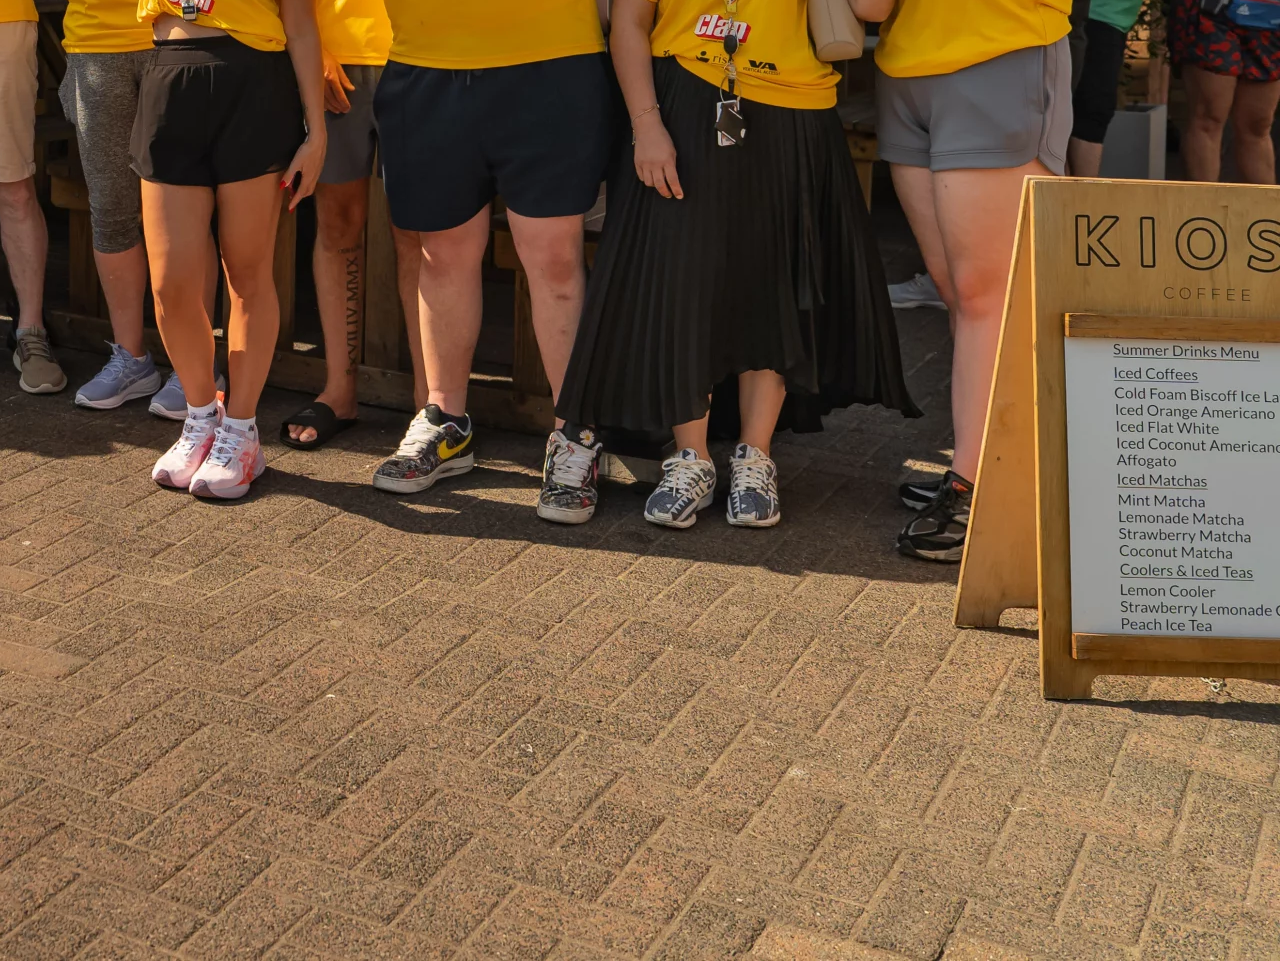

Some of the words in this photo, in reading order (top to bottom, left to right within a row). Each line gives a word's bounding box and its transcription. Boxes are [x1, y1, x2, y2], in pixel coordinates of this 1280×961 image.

[694, 14, 748, 40] Clan
[748, 59, 778, 71] VA
[1163, 285, 1252, 302] COFFEE
[1113, 343, 1170, 357] Summer
[1172, 345, 1218, 358] Drinks
[1220, 346, 1260, 360] Menu
[1114, 366, 1142, 380] Iced
[1145, 367, 1199, 381] Coffees
[1114, 386, 1146, 400] Cold
[1149, 387, 1187, 401] Foam
[1190, 388, 1238, 403] Biscoff
[1240, 390, 1261, 403] Ice
[1263, 390, 1280, 404] La
[1115, 403, 1144, 417] Iced
[1146, 404, 1198, 421] Orange
[1200, 405, 1276, 420] Americano
[1116, 420, 1145, 433] Iced
[1147, 420, 1175, 434] Flat
[1176, 421, 1220, 435] White
[1116, 436, 1145, 450] Iced
[1147, 437, 1207, 452] Coconut
[1116, 453, 1177, 470] Affogato
[1117, 472, 1146, 486] Iced
[1149, 473, 1208, 488] Matchas
[1118, 493, 1151, 507] Mint
[1153, 494, 1206, 509] Matcha
[1118, 510, 1190, 525] Lemonade
[1192, 512, 1245, 527] Matcha
[1118, 527, 1197, 545] Strawberry
[1199, 529, 1252, 544] Matcha
[1119, 544, 1178, 559] Coconut
[1181, 546, 1233, 560] Matcha
[1119, 562, 1174, 577] Coolers
[1176, 564, 1188, 578] &
[1191, 564, 1220, 578] Iced
[1221, 565, 1254, 579] Teas
[1120, 583, 1166, 597] Lemon
[1169, 584, 1217, 599] Cooler
[1120, 600, 1198, 618] Strawberry
[1201, 602, 1273, 617] Lemonade
[1121, 617, 1162, 631] Peach
[1165, 618, 1186, 632] Ice
[1187, 619, 1213, 632] Tea
